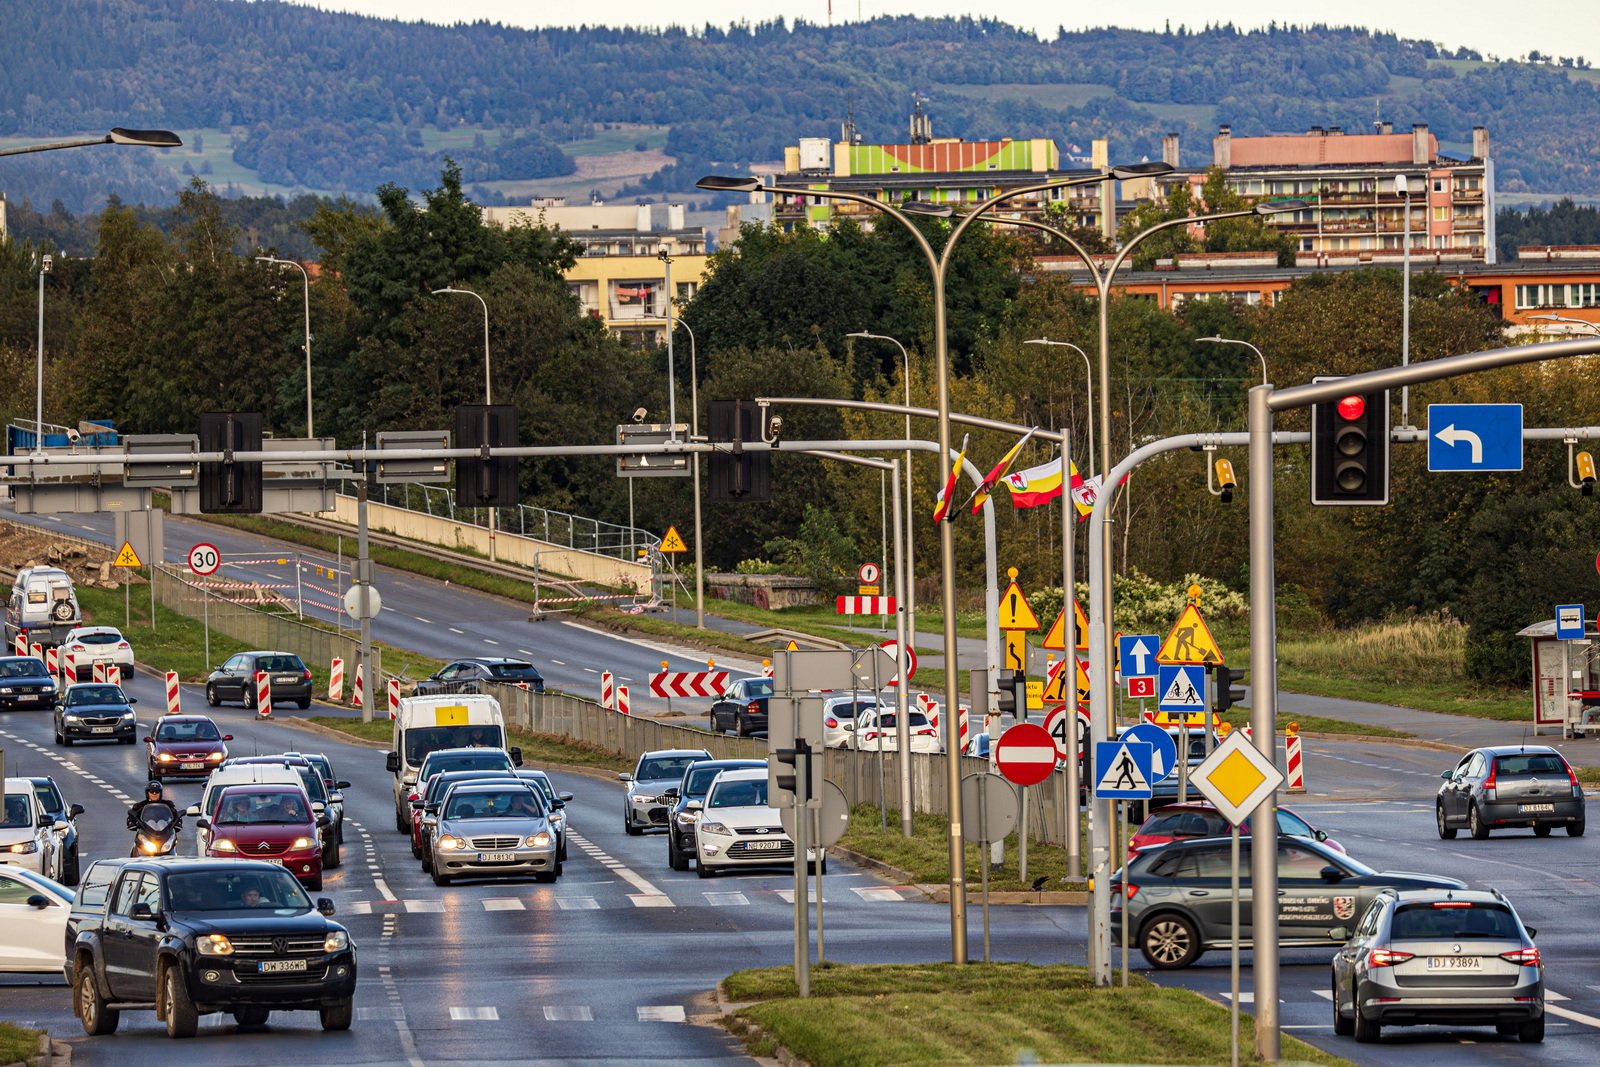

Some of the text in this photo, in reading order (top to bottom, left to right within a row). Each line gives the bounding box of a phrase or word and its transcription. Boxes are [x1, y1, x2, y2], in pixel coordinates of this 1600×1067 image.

[194, 551, 216, 568] 30
[1137, 680, 1147, 694] 3
[482, 853, 514, 861] DJ 1813C
[264, 961, 305, 972] DW 336WR
[1434, 958, 1480, 968] DJ 9389A
